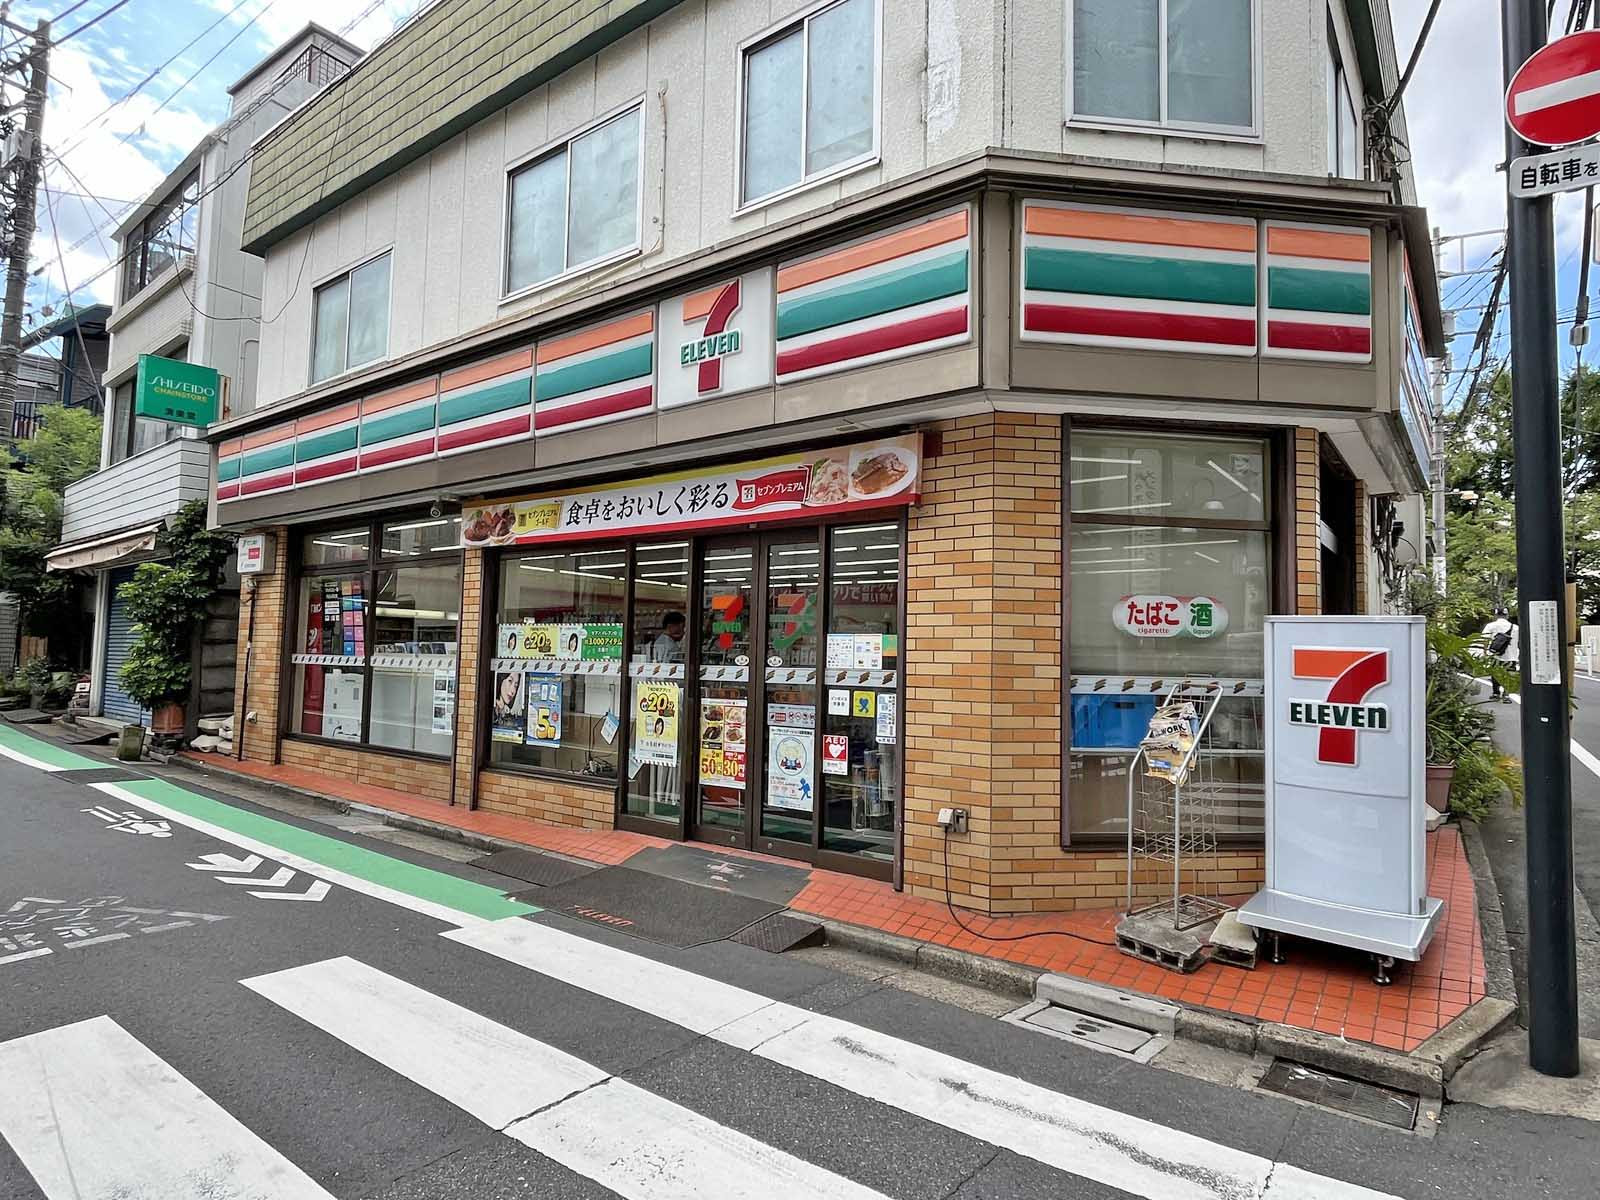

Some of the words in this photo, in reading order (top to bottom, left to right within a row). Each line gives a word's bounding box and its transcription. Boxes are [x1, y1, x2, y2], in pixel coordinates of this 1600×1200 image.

[1520, 158, 1598, 190] 自転車を
[148, 376, 215, 397] SHISEIDO
[757, 482, 804, 496] セブンプレミアム
[566, 482, 730, 526] 食卓をおいしく彩る
[1127, 601, 1180, 626] たばこ
[1190, 602, 1213, 627] 酒
[1138, 627, 1169, 635] cigarette
[1294, 650, 1387, 765] 7
[825, 736, 846, 745] AED
[701, 758, 716, 775] 50
[723, 759, 738, 777] 30
